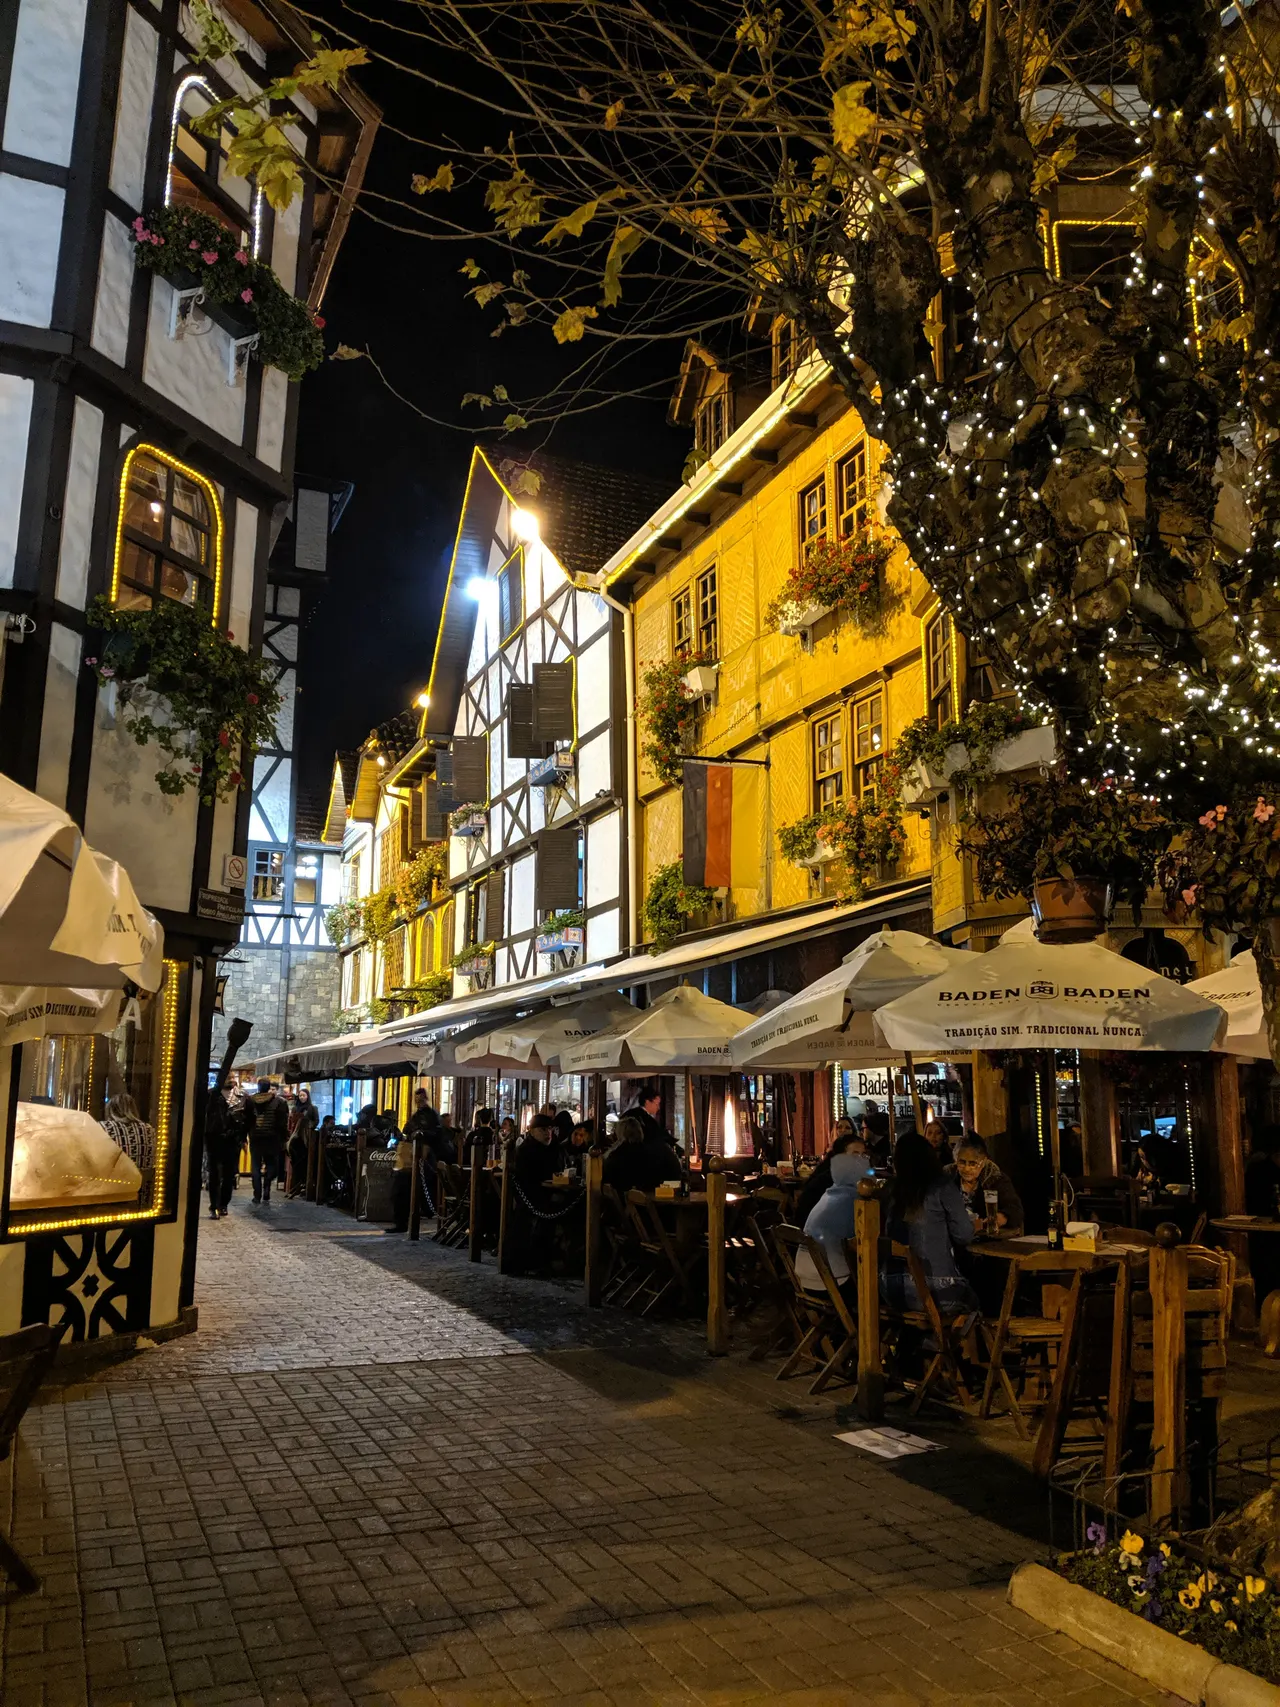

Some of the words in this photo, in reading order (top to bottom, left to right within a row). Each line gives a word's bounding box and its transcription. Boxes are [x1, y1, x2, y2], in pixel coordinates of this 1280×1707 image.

[939, 988, 1020, 1001] BADEN
[1064, 987, 1150, 999] BADEN
[944, 1024, 998, 1039] TRADIÇÃO
[1000, 1025, 1023, 1036] SIM.
[1026, 1025, 1100, 1036] TRADICIONAL
[1102, 1025, 1147, 1037] NUNCA.
[697, 1046, 722, 1054] BADEN
